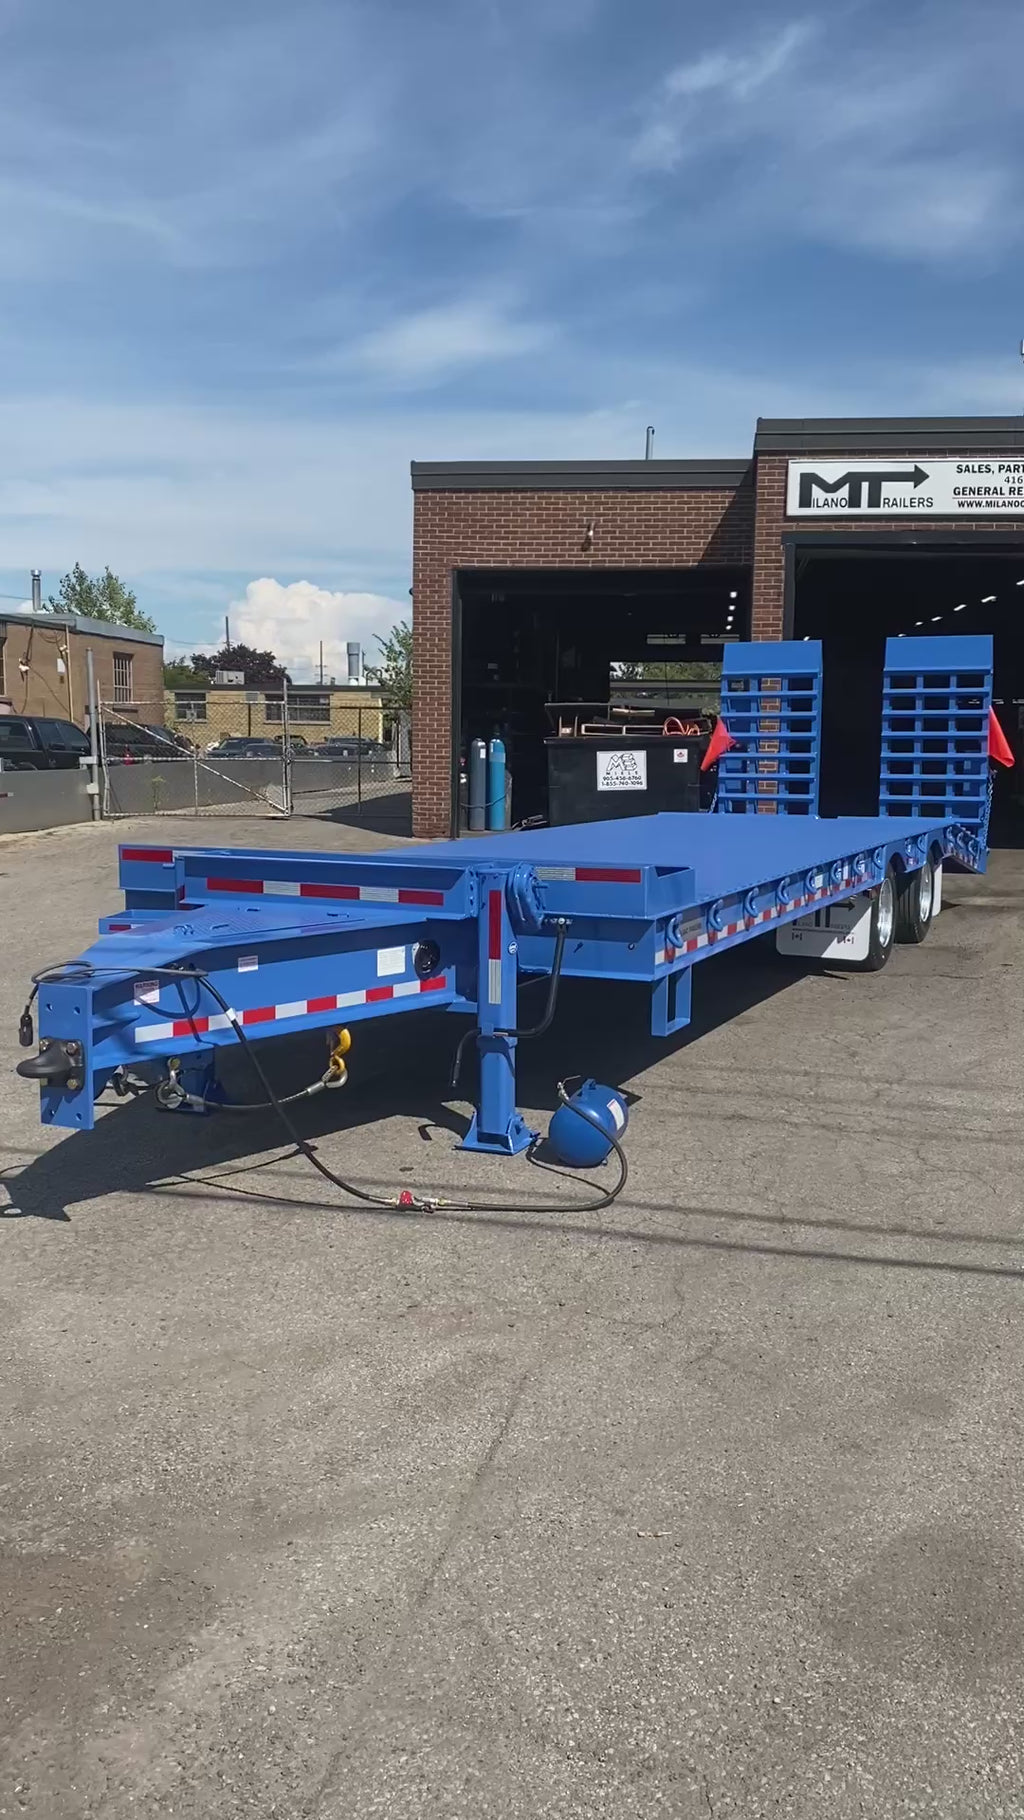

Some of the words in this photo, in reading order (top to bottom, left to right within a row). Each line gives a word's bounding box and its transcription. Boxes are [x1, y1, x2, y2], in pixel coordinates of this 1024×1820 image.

[956, 464, 995, 474] SALES,
[1004, 475, 1023, 484] 416
[953, 486, 1005, 496] GENERAL
[1009, 486, 1023, 496] RE
